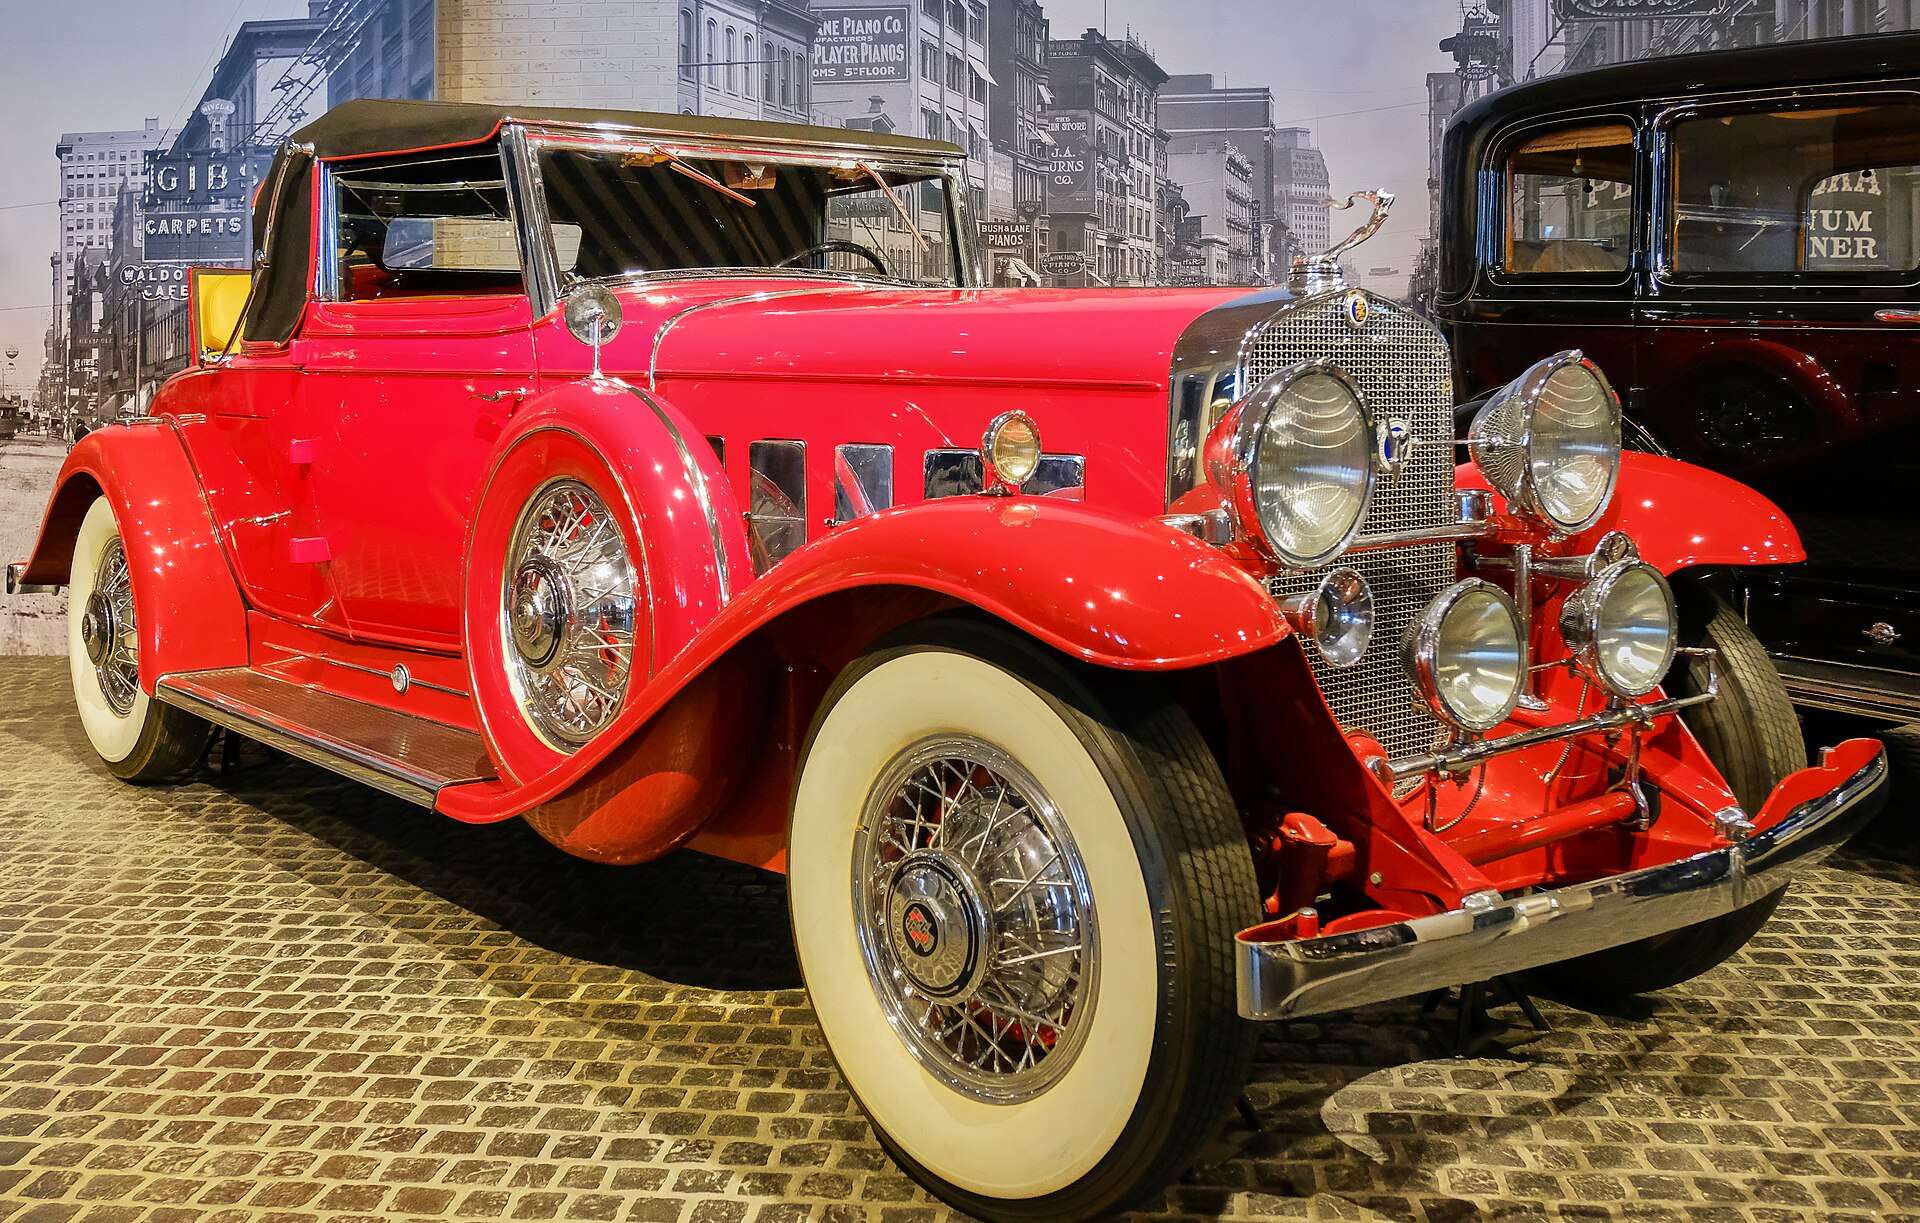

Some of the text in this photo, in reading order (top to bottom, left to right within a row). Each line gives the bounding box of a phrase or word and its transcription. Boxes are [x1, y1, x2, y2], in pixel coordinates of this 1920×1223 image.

[843, 16, 882, 35] PIANO
[813, 35, 873, 43] UFACTURERS
[1061, 122, 1087, 131] STORE
[145, 217, 241, 235] CARPETS
[988, 234, 1024, 246] PIANOS
[1808, 236, 1879, 259] NER
[123, 268, 184, 281] WALDO
[143, 285, 190, 297] CAFE
